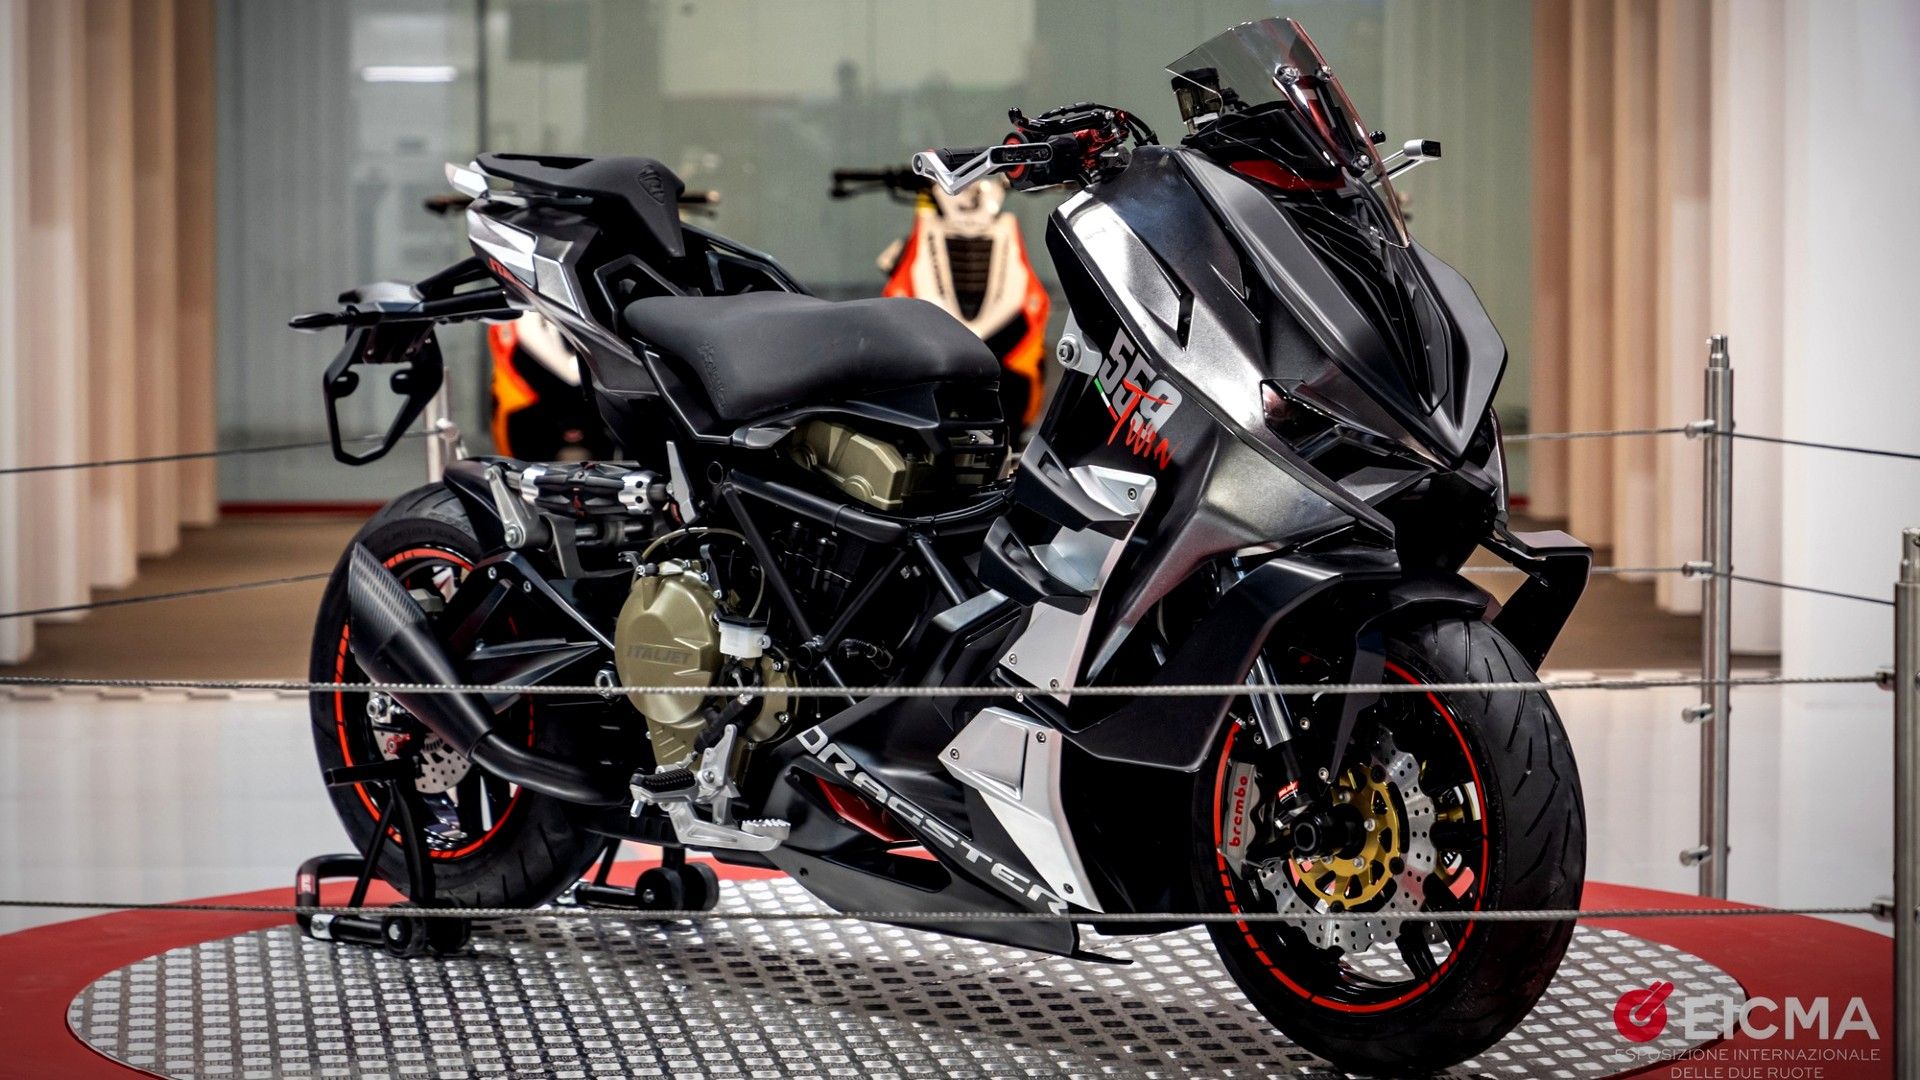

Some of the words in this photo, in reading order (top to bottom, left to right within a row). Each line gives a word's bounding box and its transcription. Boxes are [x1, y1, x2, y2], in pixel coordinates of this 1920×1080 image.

[1098, 327, 1183, 443] 559
[627, 645, 693, 665] ITALJET
[796, 725, 1068, 916] DRAGSTER
[1229, 776, 1248, 847] brembo
